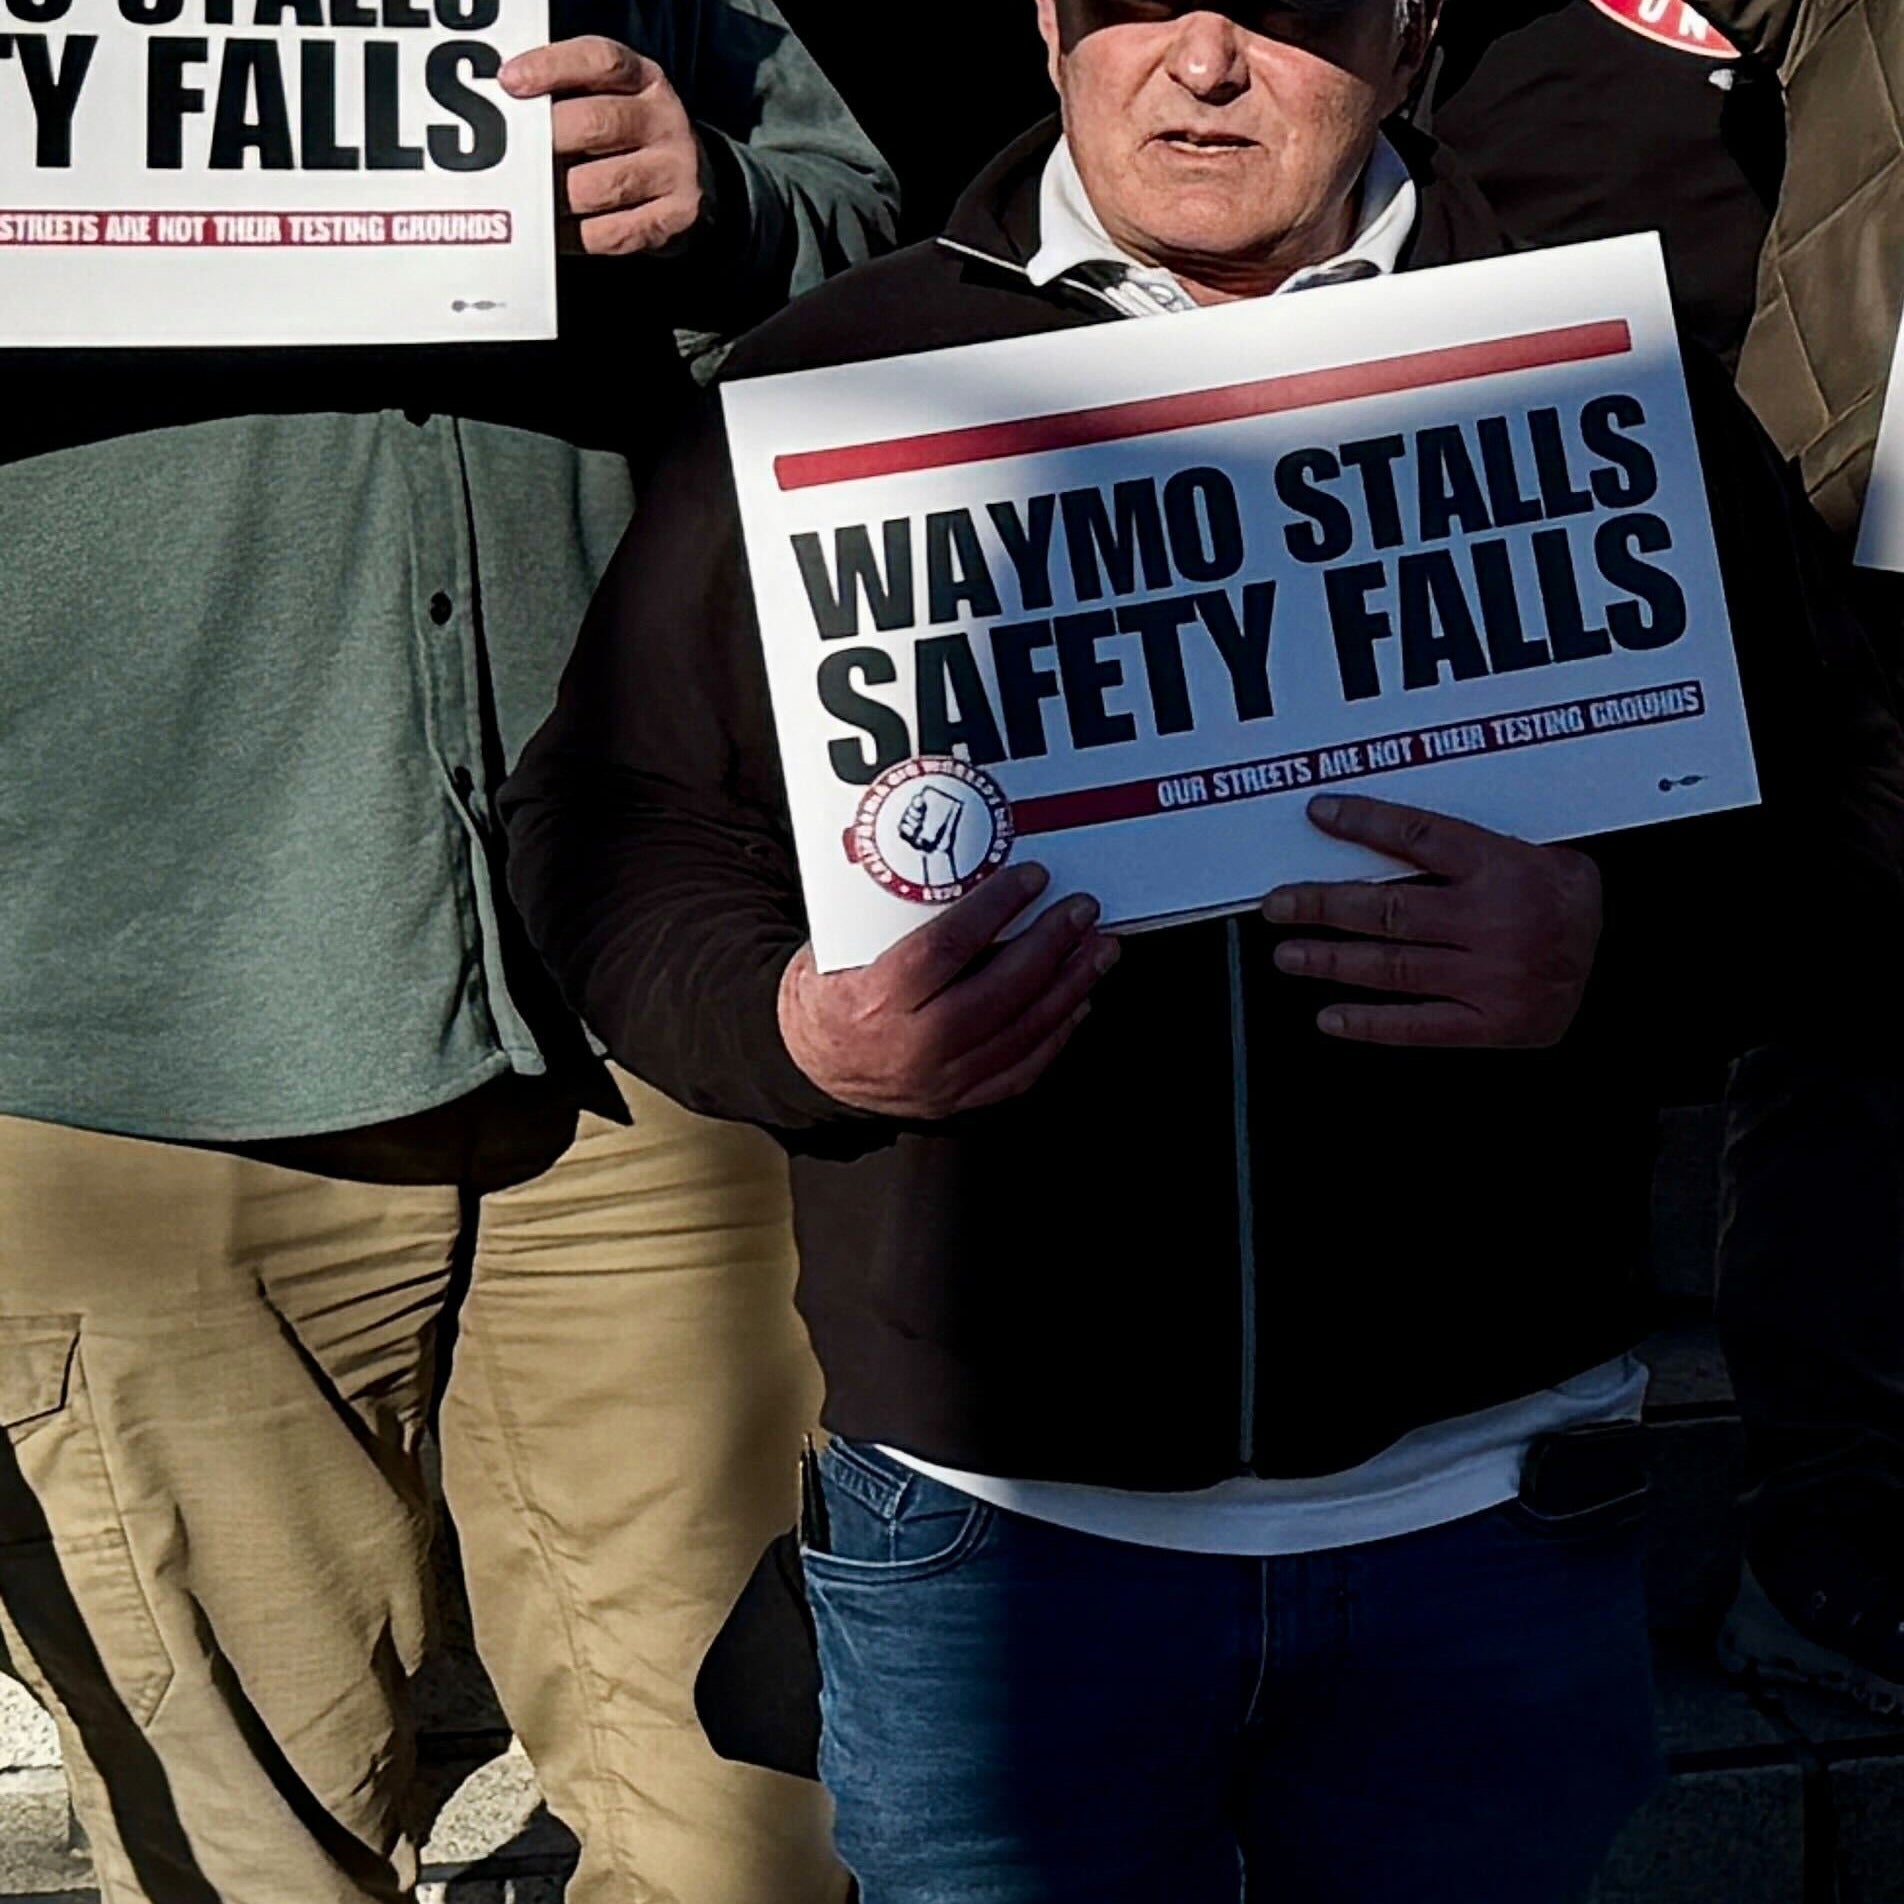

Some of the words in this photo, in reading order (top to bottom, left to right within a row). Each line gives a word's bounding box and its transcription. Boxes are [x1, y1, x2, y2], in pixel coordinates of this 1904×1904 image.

[146, 36, 508, 172] FALLS
[0, 213, 99, 243] STREETS
[104, 213, 151, 243] ARE
[157, 213, 204, 243] NOT
[211, 213, 282, 244] THEIR
[287, 212, 385, 244] TESTING
[392, 211, 508, 243] GROUNDS
[790, 464, 1244, 640] WAYMO
[1272, 392, 1658, 564] STALLS
[816, 580, 1276, 789] SAFETY
[1323, 511, 1688, 702] FALLS
[1156, 773, 1208, 808] OUR
[1213, 755, 1312, 799] STREETS
[1318, 743, 1364, 777] ARE
[1367, 735, 1414, 767] NOT
[1420, 722, 1487, 761] THEIR
[1491, 705, 1586, 747] TESTING
[1590, 686, 1700, 730] GROUNDS
